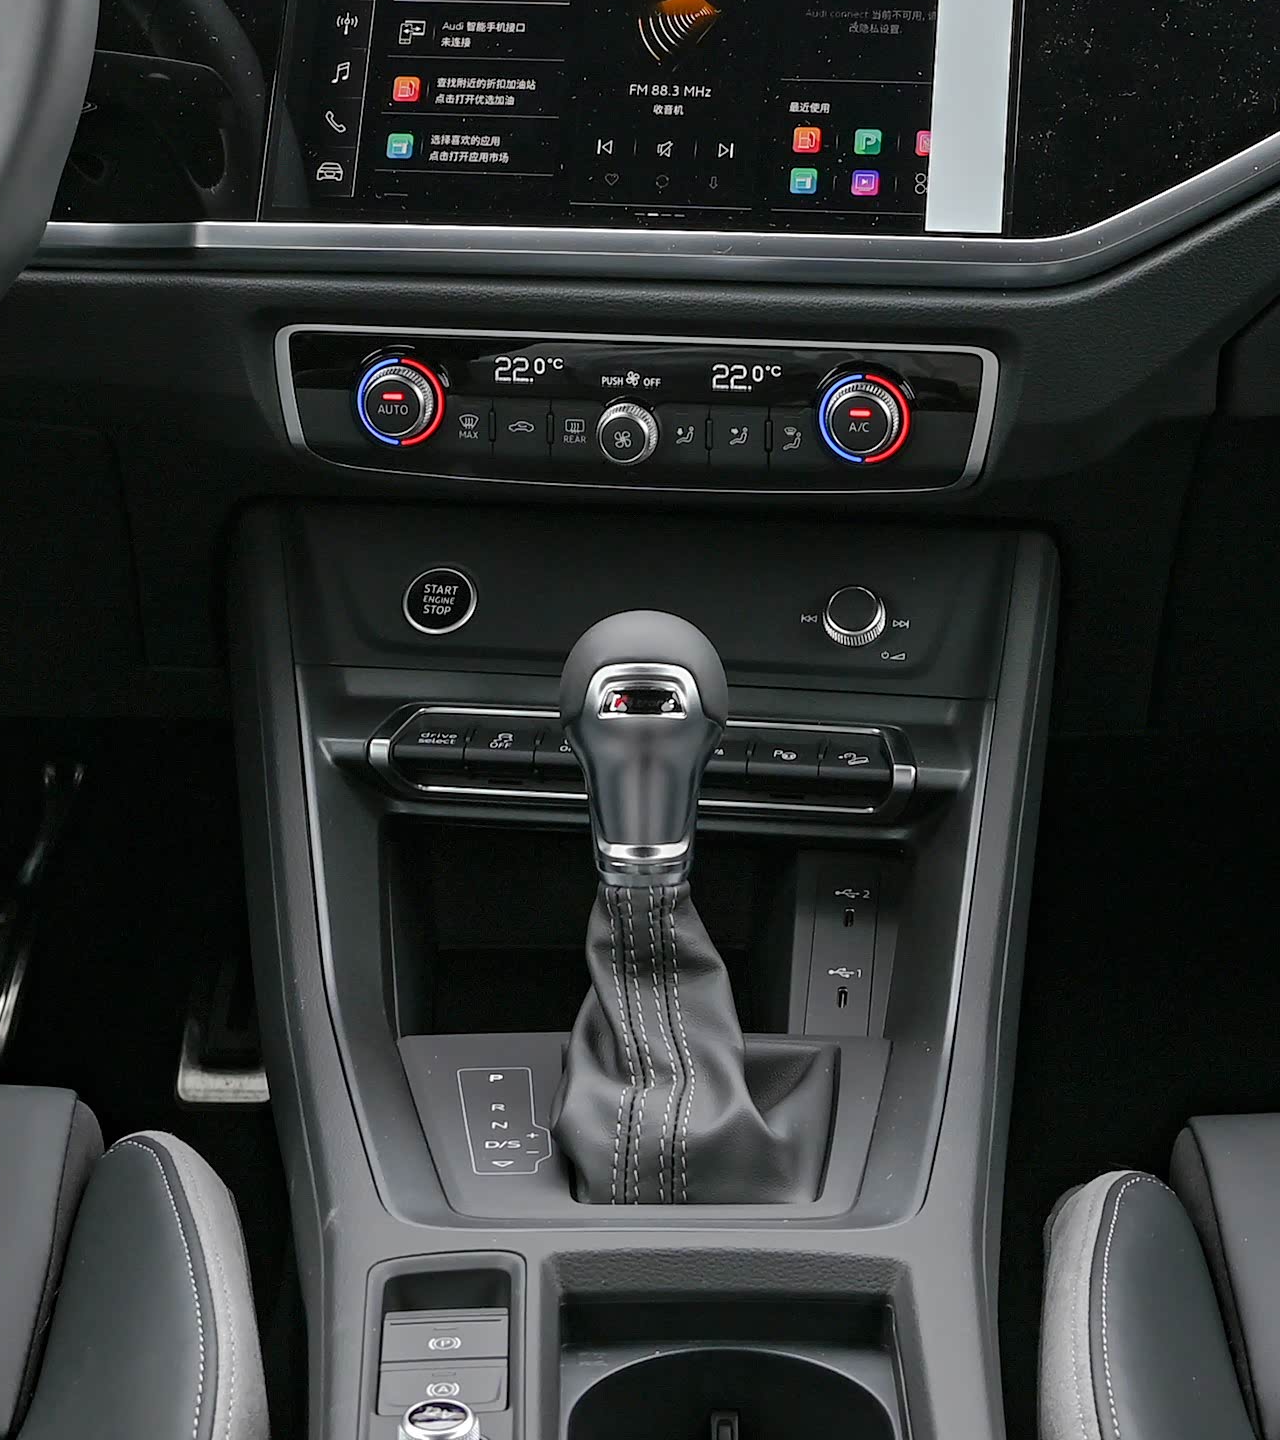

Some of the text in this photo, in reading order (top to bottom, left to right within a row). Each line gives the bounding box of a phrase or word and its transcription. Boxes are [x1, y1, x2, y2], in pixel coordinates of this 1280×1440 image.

[806, 10, 828, 19] Audi
[829, 10, 869, 20] connect
[441, 21, 526, 33] Audi 智能手机接口
[440, 37, 471, 48] 未连接
[436, 77, 537, 91] 查找附近的折扣加油站
[629, 83, 712, 98] FM 88.3 MHz
[434, 93, 515, 106] 点击打开优选加油
[652, 104, 684, 116] 收音机
[788, 101, 831, 114] 最近使用
[430, 134, 501, 147] 选择喜欢的应用
[428, 150, 510, 164] 点击打开应用市场
[601, 376, 661, 388] PUSH OFF
[377, 404, 409, 416] AUTO
[848, 421, 870, 433] A/C
[458, 429, 479, 439] MAX
[563, 434, 587, 444] REAR
[423, 583, 459, 596] START
[423, 595, 456, 606] ENGINE
[423, 604, 452, 616] STOP
[420, 731, 458, 740] drive
[418, 737, 457, 746] select
[489, 740, 513, 750] OFF
[862, 889, 871, 899] 2
[855, 968, 863, 979] 1
[489, 1073, 504, 1082] P
[491, 1103, 506, 1112] R
[491, 1121, 509, 1130] N
[485, 1140, 521, 1149] D/S
